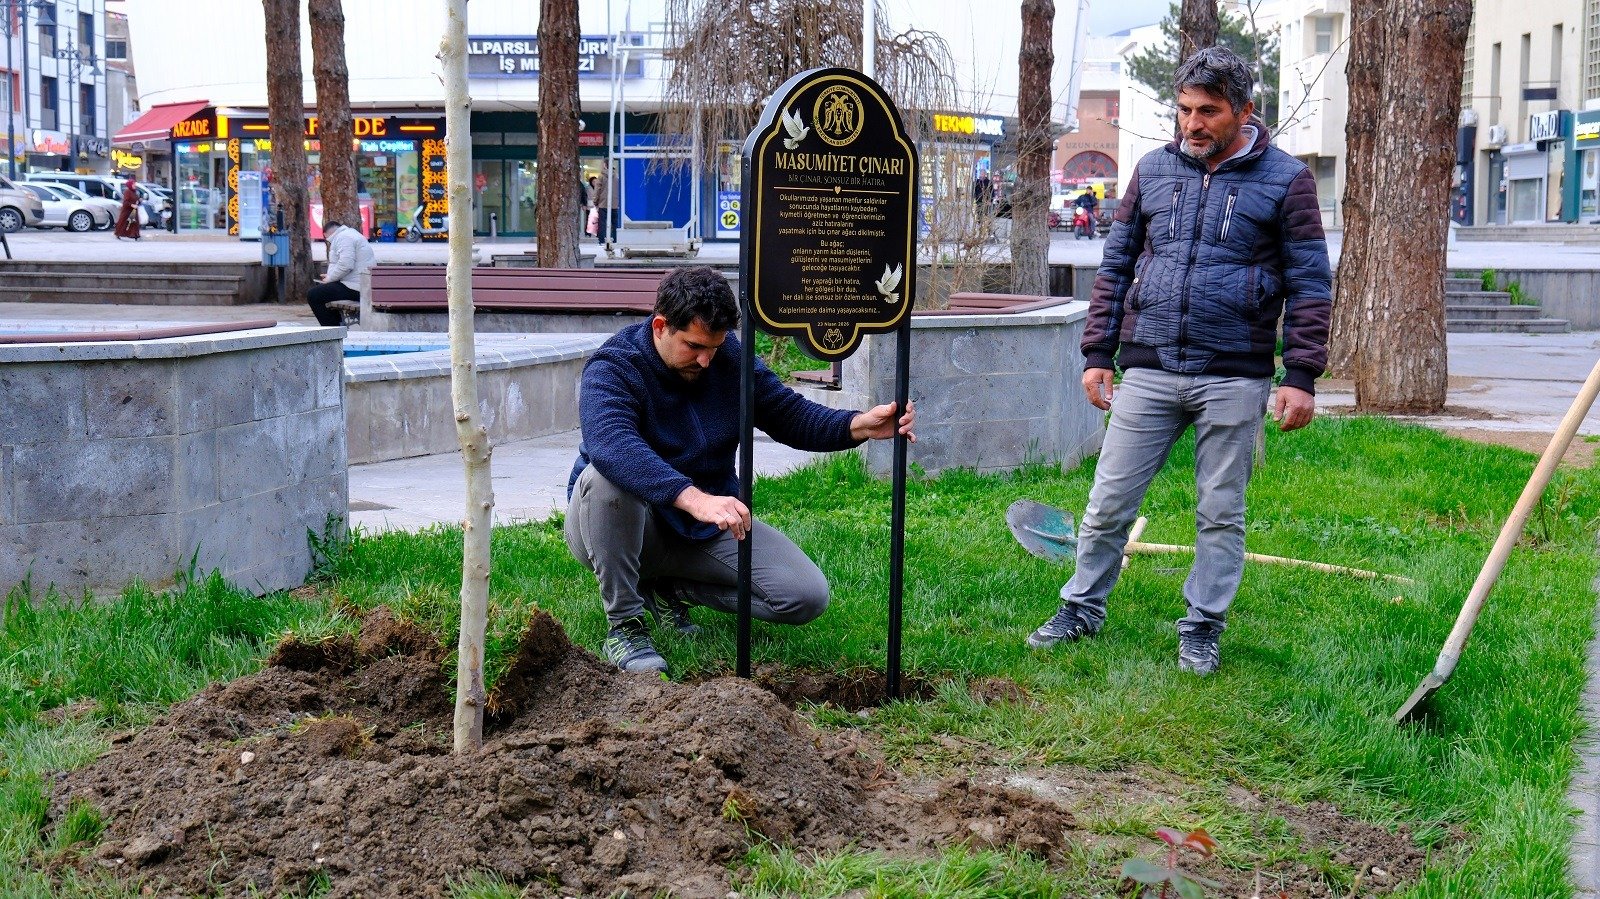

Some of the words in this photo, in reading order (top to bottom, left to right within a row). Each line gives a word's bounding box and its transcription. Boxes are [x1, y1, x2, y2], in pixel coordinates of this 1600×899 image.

[500, 55, 515, 74] İŞ
[173, 119, 210, 138] ARZADE
[775, 152, 856, 172] MASUMİYET
[859, 156, 904, 176] ÇINARI
[788, 174, 799, 182] BİR
[850, 176, 861, 185] BİR
[862, 177, 885, 186] HATIRA
[780, 194, 818, 202] Okullarımızda
[820, 196, 842, 204] yaşanan
[820, 204, 850, 212] hayatlarını
[723, 214, 736, 226] 12
[804, 212, 830, 220] öğretmen
[842, 212, 886, 220] öğrencilerimizin
[824, 220, 854, 228] hatıralarını
[778, 228, 806, 236] yaşatmak
[806, 228, 816, 236] için
[790, 256, 820, 264] gülüşlerini
[812, 278, 834, 286] yaprağı
[844, 278, 860, 286] hatıra,
[815, 286, 836, 294] gölgesi
